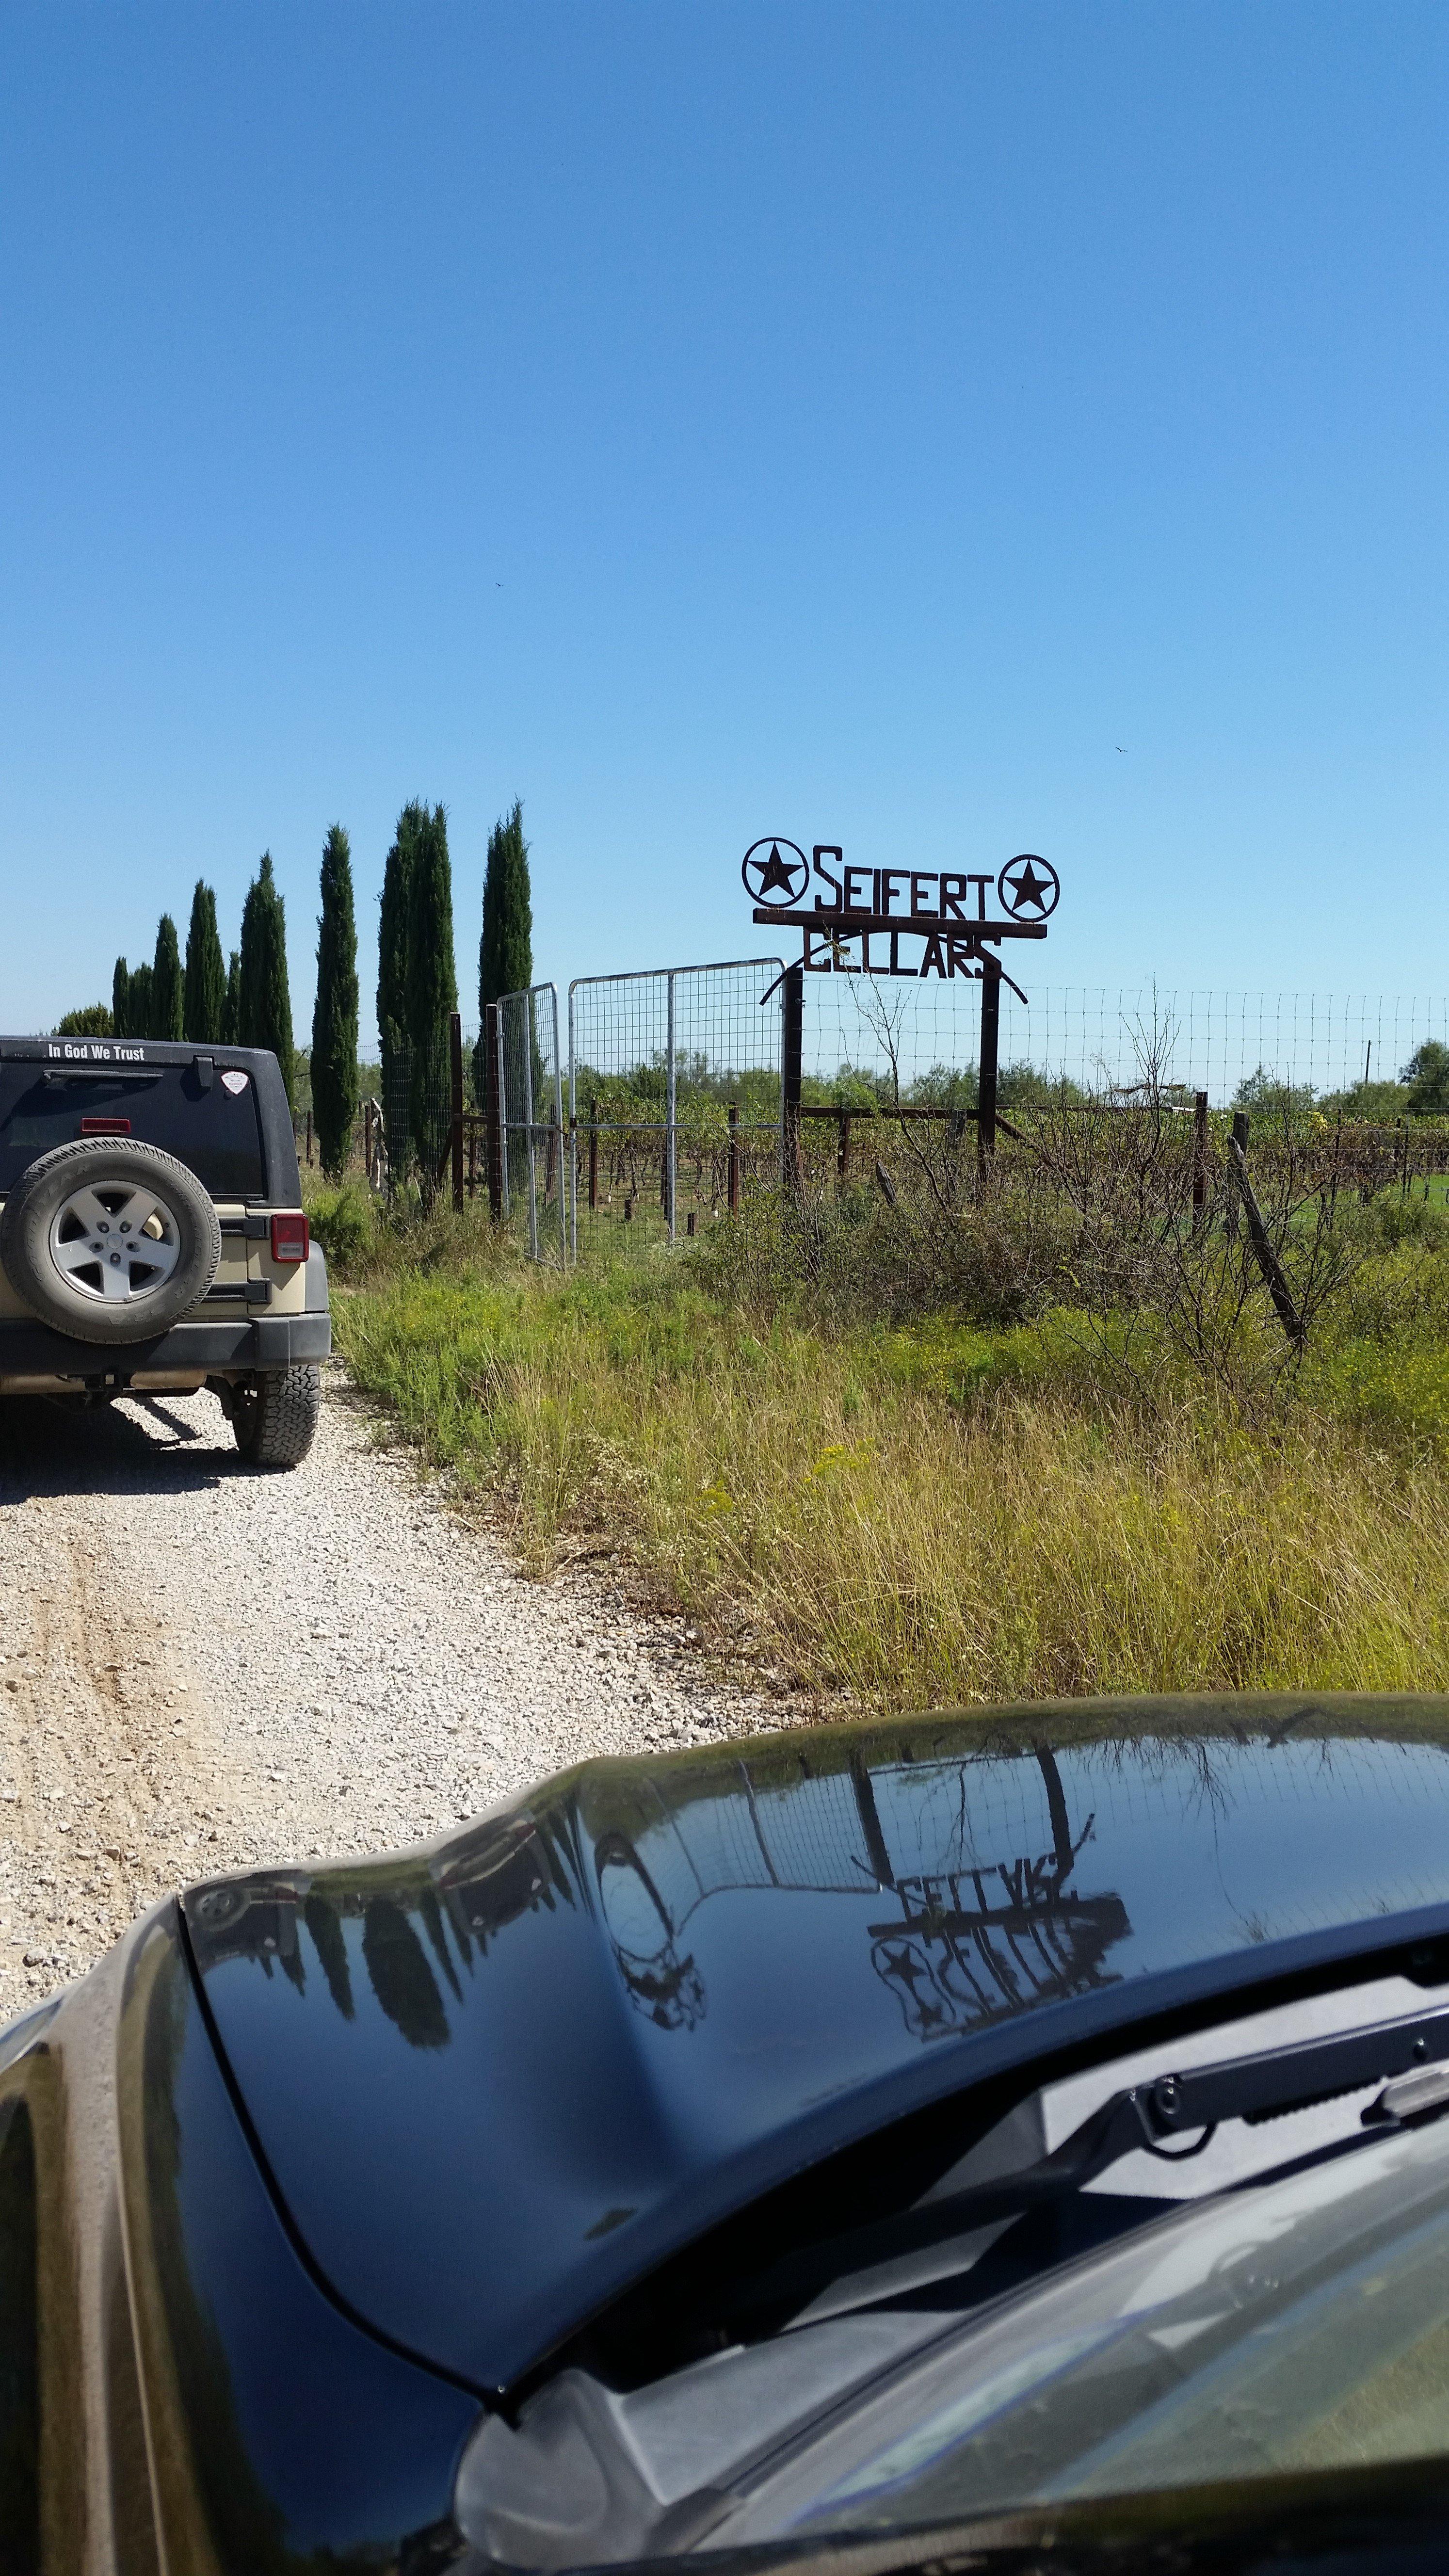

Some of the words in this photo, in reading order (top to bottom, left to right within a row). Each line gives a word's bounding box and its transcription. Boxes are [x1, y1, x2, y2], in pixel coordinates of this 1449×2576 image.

[813, 845, 994, 920] SEIFERT
[803, 926, 1002, 979] CELLARS
[48, 1043, 61, 1058] In
[64, 1044, 88, 1058] God
[91, 1045, 111, 1059] We
[113, 1046, 145, 1061] Trust
